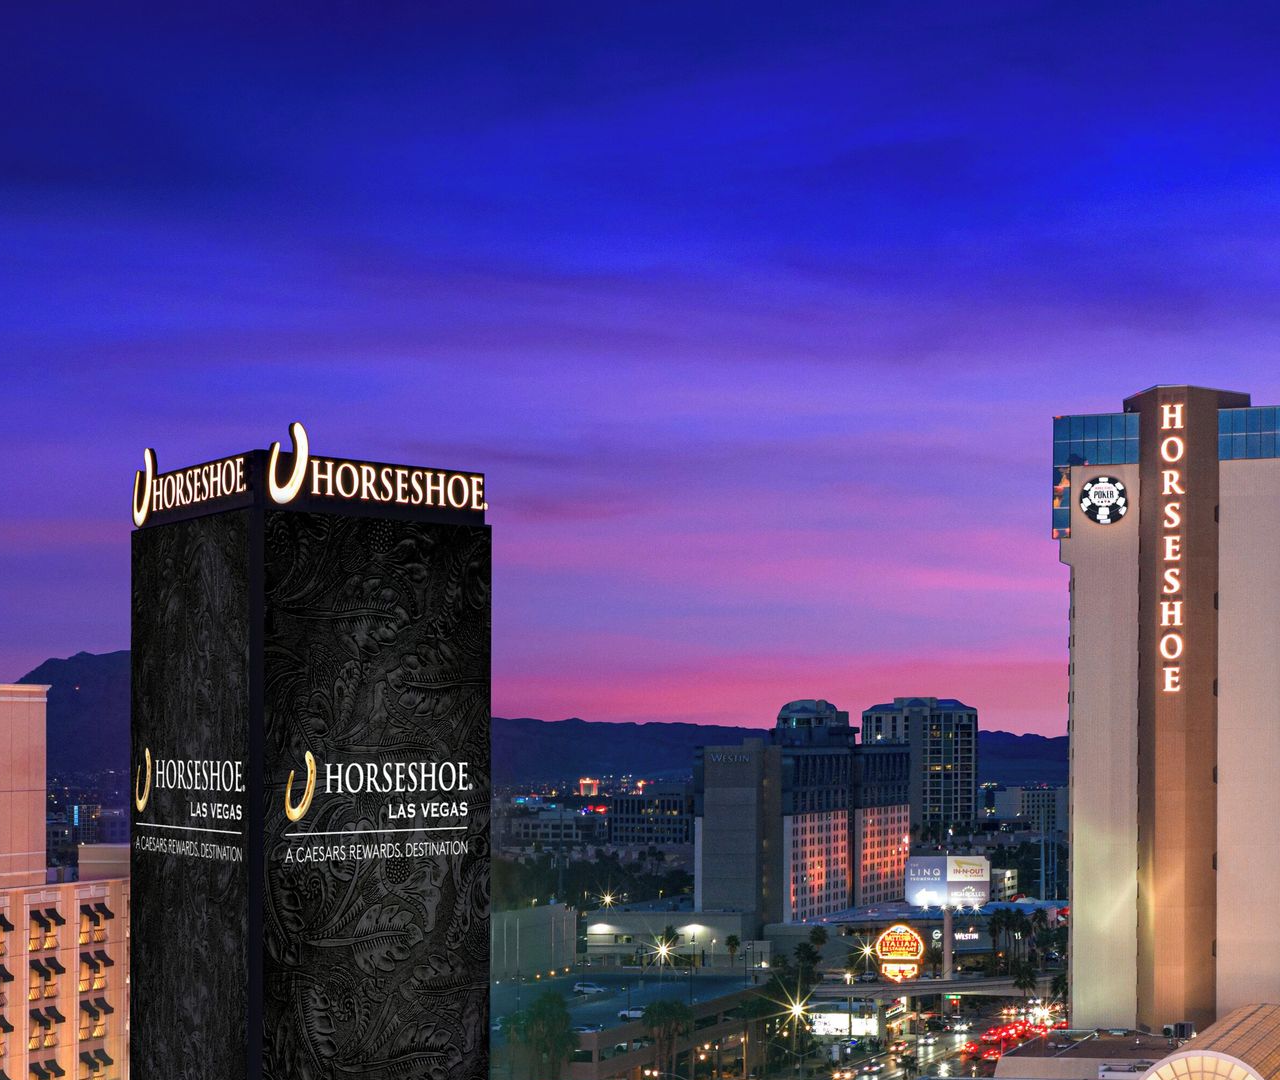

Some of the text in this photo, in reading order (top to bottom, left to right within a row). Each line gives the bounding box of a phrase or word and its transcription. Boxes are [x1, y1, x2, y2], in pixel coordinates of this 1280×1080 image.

[152, 457, 246, 512] HORSESHOE
[311, 459, 485, 510] HORSESHOE
[1094, 490, 1114, 498] POKER
[1160, 404, 1185, 692] HORSESHOE
[711, 753, 751, 762] WESTIN
[155, 759, 243, 792] HORSESHOE
[324, 761, 469, 794] HORSESHOE
[190, 801, 243, 820] LAS VEGAS
[388, 801, 468, 819] LAS VEGAS
[141, 835, 167, 853] CAESARS
[201, 843, 243, 862] DESTINATION
[285, 848, 294, 863] A
[296, 845, 346, 863] CAESARS
[406, 841, 469, 857] DESTINATION
[910, 868, 941, 877] LINQ
[954, 932, 979, 941] WESTIN
